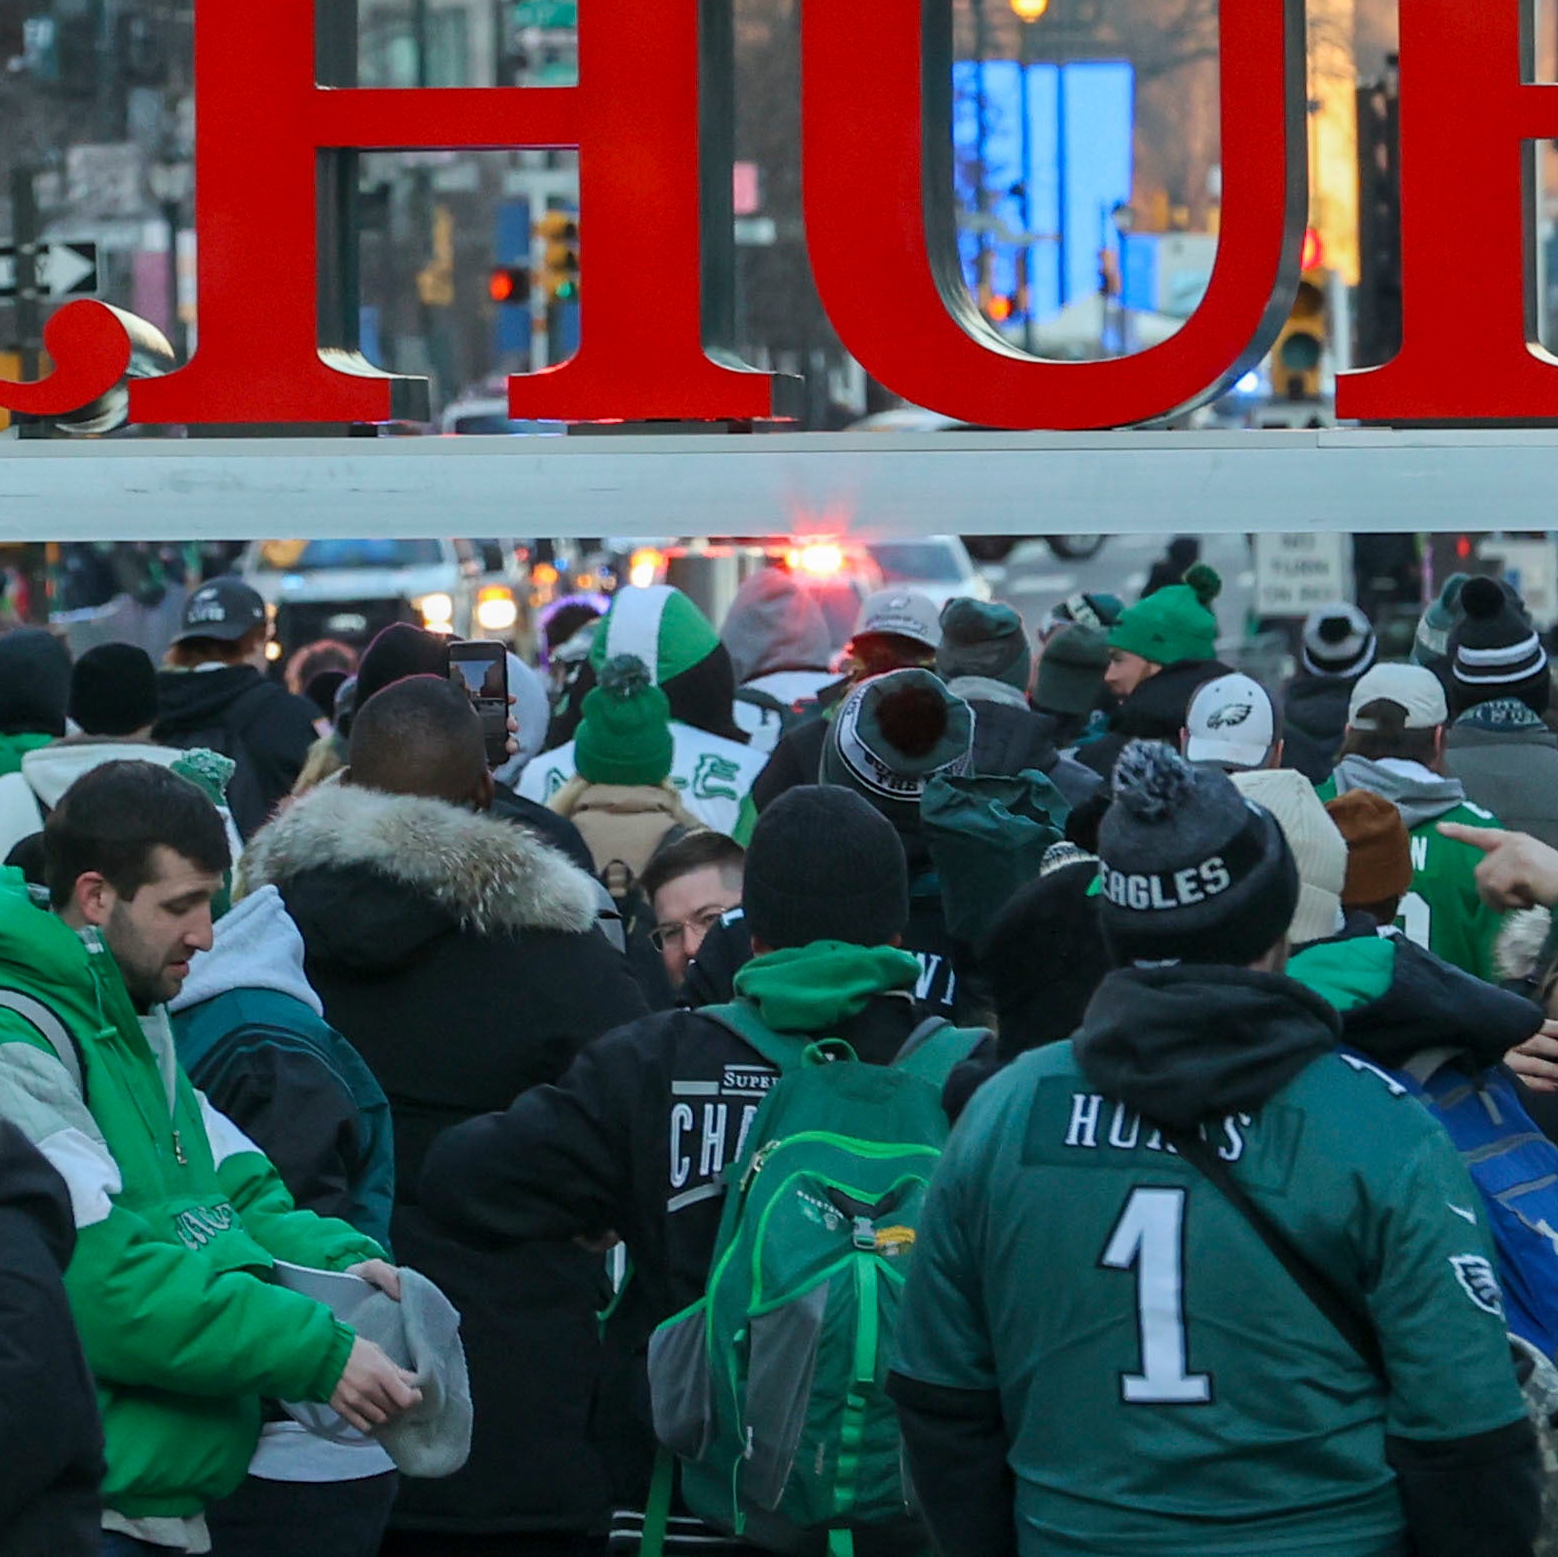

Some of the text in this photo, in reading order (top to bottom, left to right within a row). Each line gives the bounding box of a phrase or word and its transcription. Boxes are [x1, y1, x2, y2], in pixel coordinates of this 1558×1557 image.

[1098, 856, 1231, 910] EAGLES
[1064, 1094, 1252, 1162] HUS
[1100, 1185, 1214, 1404] 1
